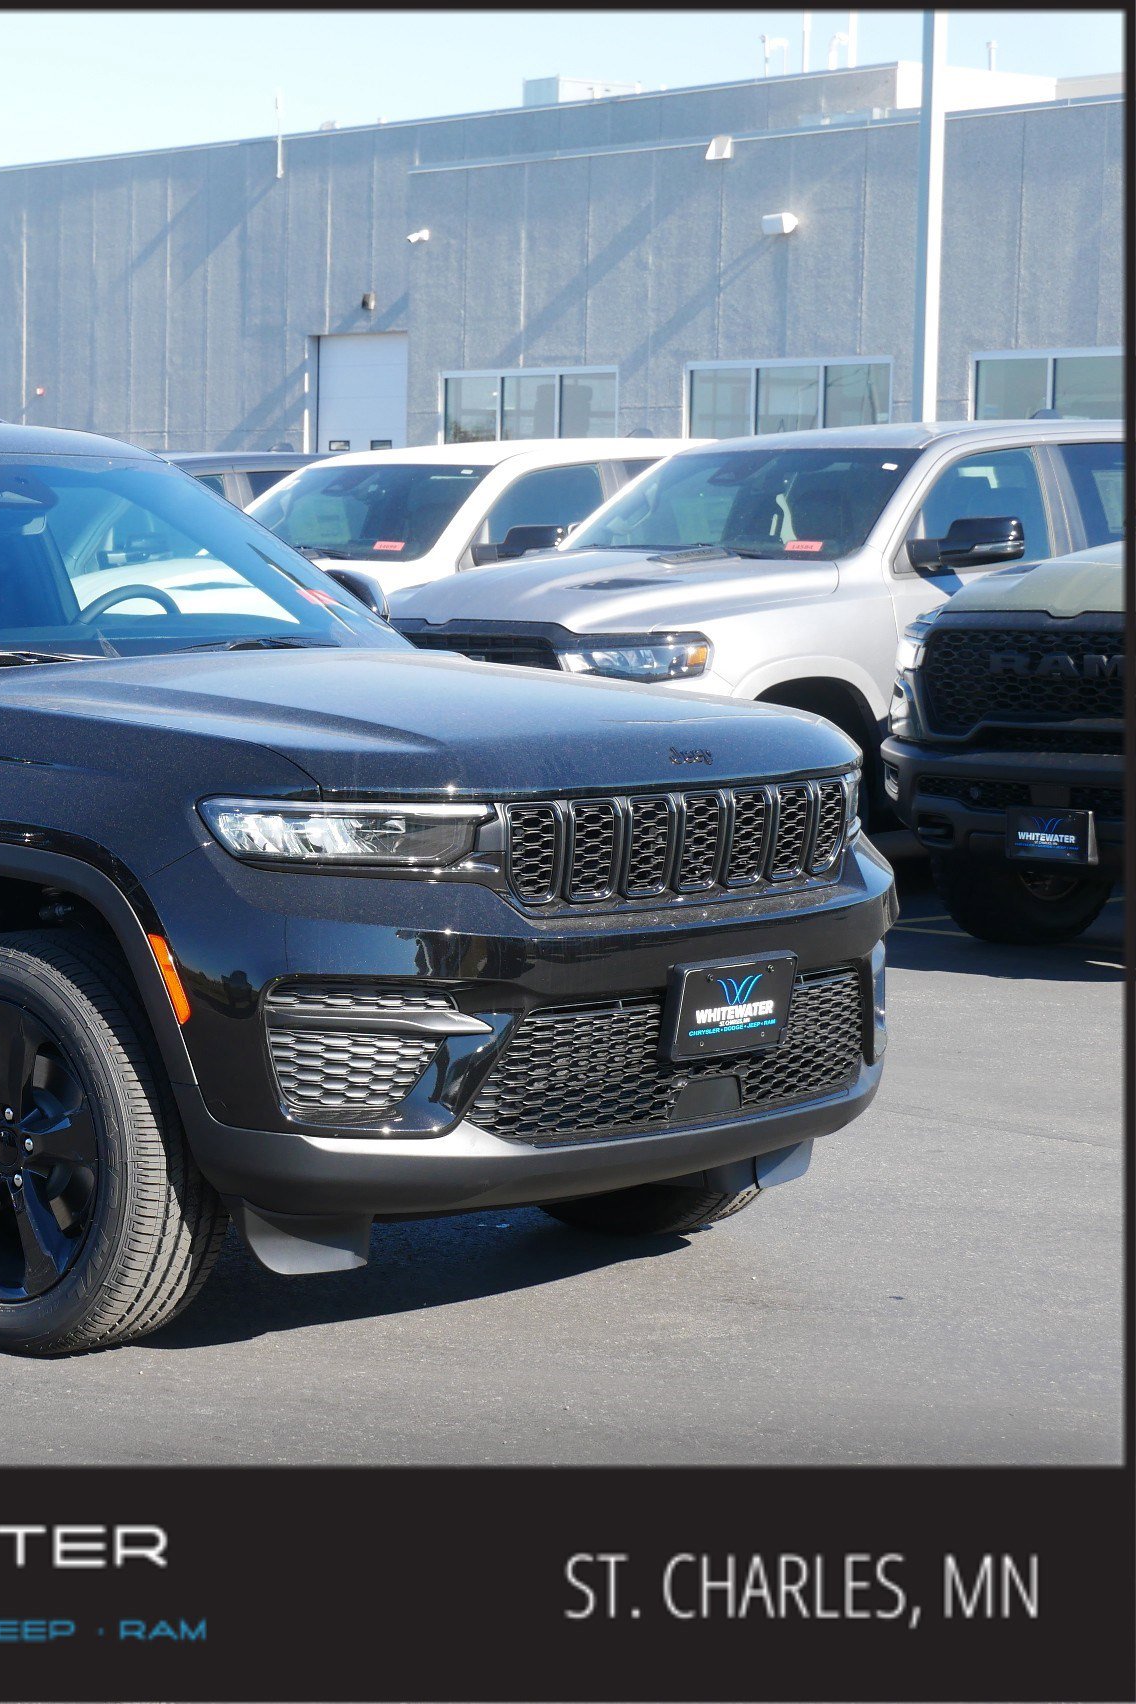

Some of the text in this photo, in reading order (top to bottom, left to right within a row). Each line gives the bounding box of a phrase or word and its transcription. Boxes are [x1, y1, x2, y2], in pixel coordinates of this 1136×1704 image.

[989, 651, 1126, 678] RAM
[1017, 831, 1076, 844] WHITEWATER
[695, 1000, 774, 1024] WHITEWATER
[688, 1028, 721, 1036] CHRYSLER
